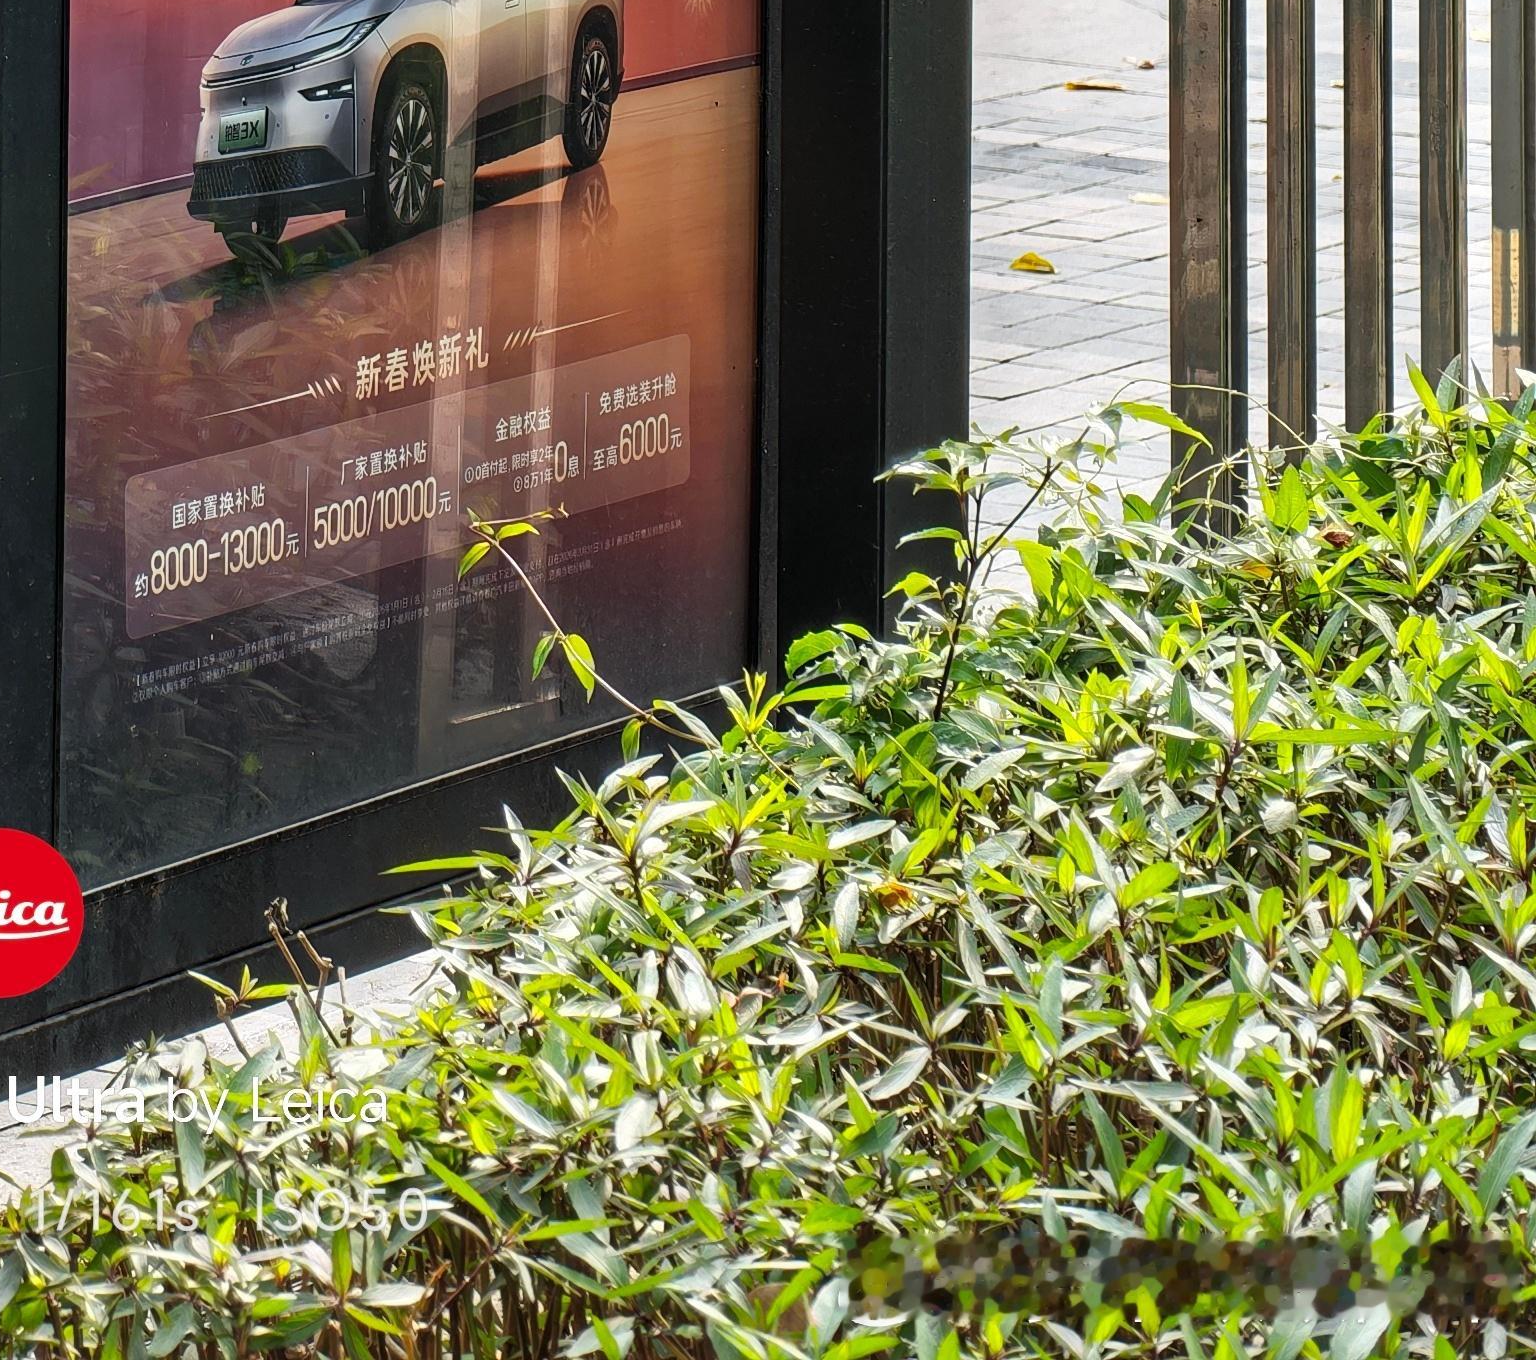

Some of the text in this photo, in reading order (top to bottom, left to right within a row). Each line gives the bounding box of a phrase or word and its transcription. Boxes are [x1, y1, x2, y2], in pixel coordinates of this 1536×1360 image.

[355, 326, 489, 400] 新春焕新礼
[599, 372, 677, 416] 免费选装升舱
[495, 405, 552, 442] 金融权益
[341, 440, 428, 485] 厂家置换补贴
[172, 485, 265, 529] 国家置换补贴
